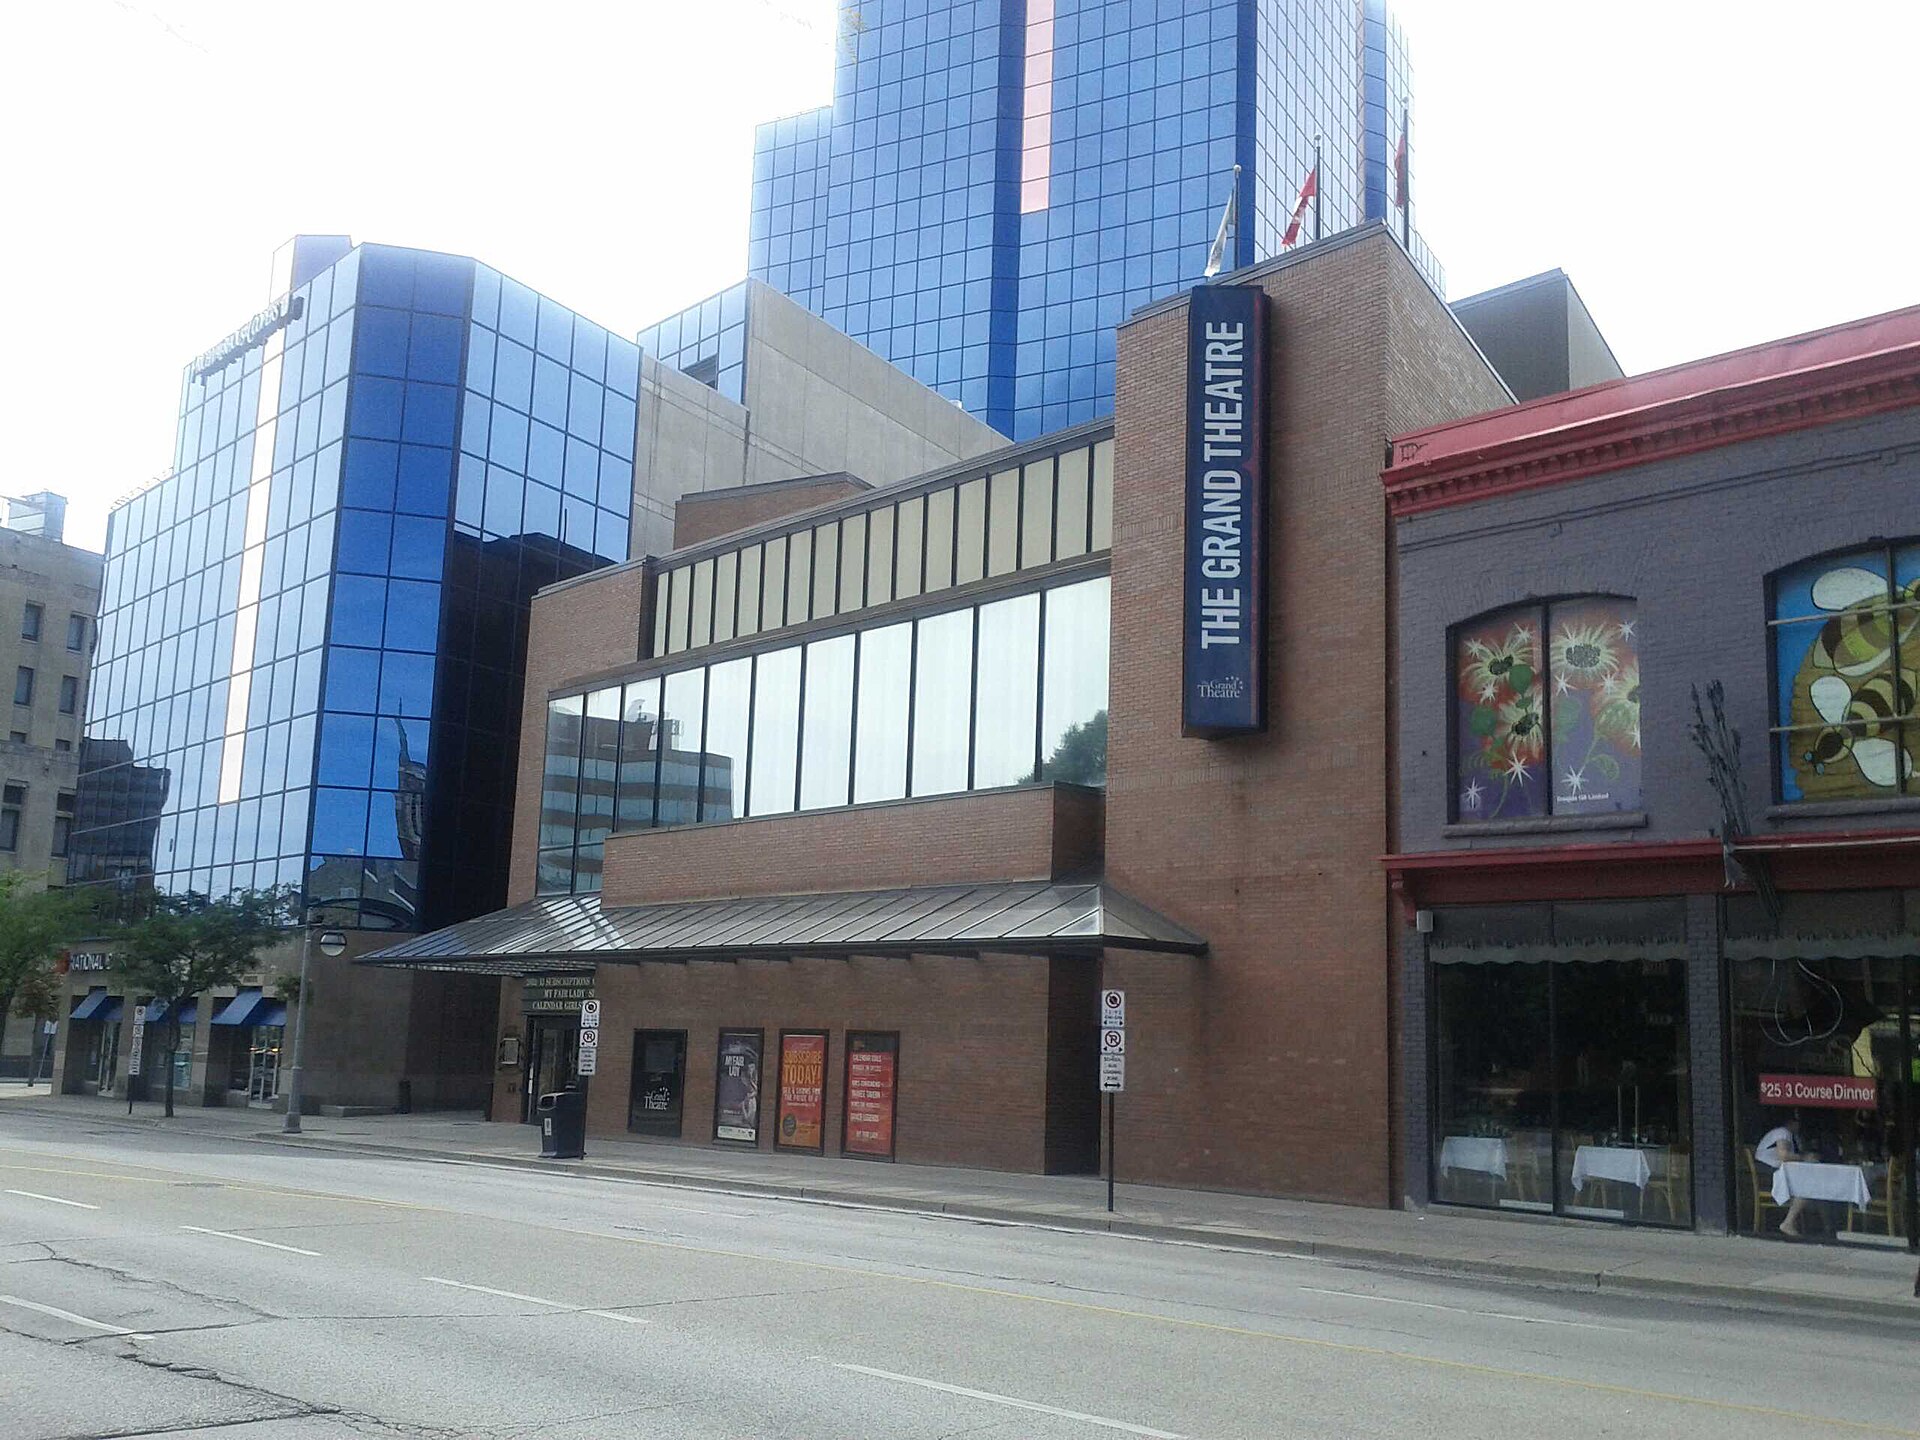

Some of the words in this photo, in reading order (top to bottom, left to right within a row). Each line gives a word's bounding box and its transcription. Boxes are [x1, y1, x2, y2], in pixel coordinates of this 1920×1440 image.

[1204, 321, 1244, 463] THEATRE
[1202, 469, 1242, 579] GRAND
[1201, 588, 1241, 649] THE
[1197, 685, 1240, 698] Theatre
[71, 953, 104, 970] NATIONAL
[532, 1001, 563, 1010] CALENDAR
[784, 1064, 821, 1085] TODAY!
[1761, 1082, 1781, 1097] $25
[1785, 1083, 1792, 1098] 3
[1795, 1083, 1832, 1099] Course
[1834, 1083, 1875, 1100] Dinner
